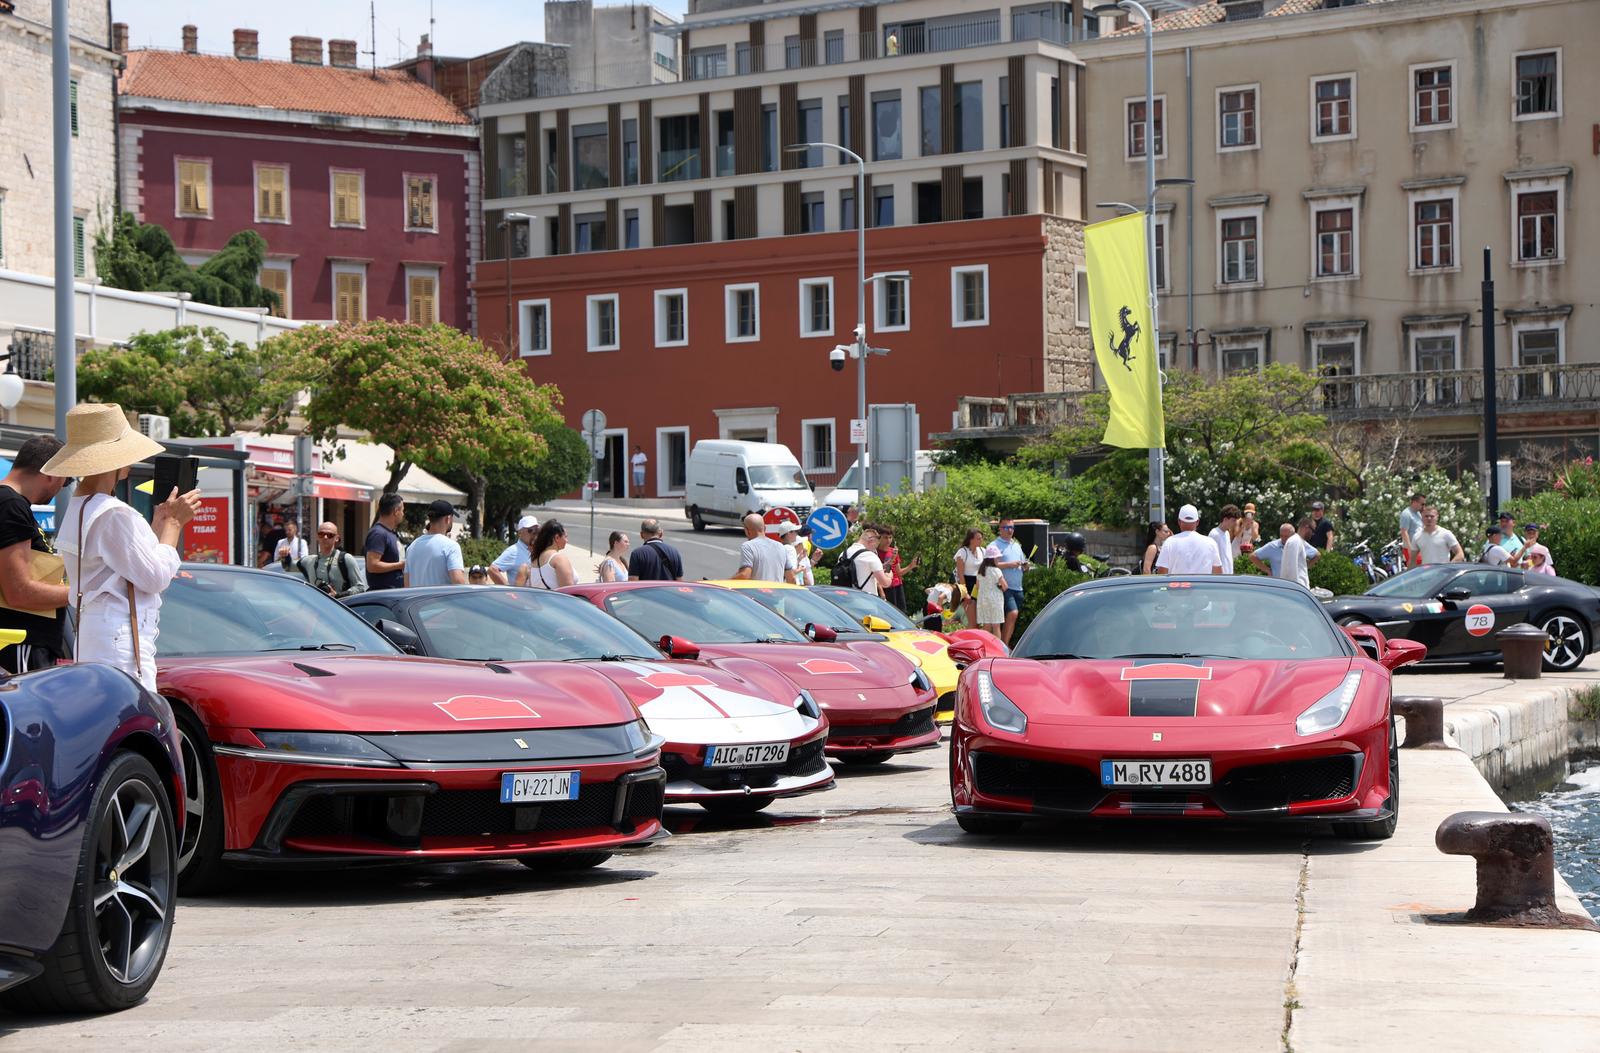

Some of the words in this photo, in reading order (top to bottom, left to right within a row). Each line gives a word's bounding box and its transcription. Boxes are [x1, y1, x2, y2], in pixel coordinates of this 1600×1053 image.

[1472, 616, 1488, 626] 78
[714, 748, 738, 764] AIC
[1114, 764, 1127, 782] M
